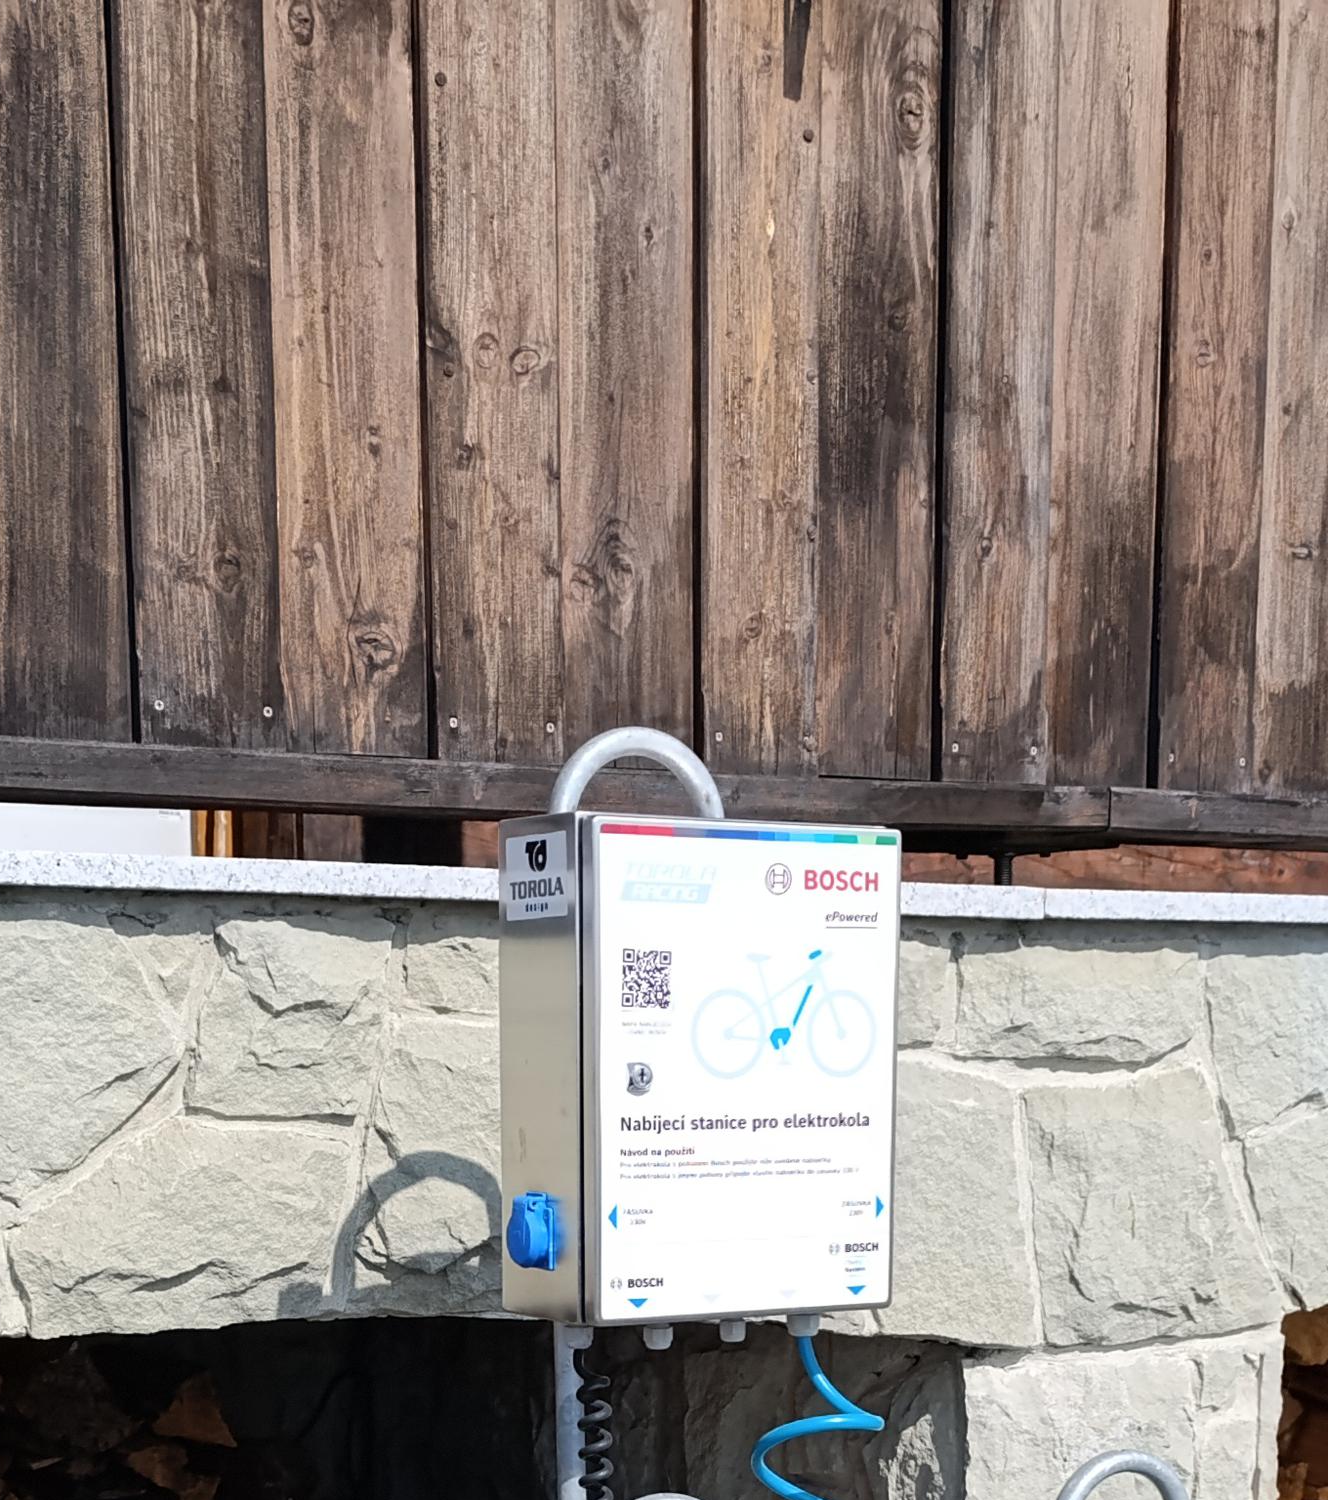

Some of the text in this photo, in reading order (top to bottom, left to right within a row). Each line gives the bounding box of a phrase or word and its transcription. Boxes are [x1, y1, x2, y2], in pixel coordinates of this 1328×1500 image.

[510, 877, 564, 900] TOROLA
[804, 869, 879, 892] BOSCH
[825, 911, 878, 923] ePowered
[691, 1114, 747, 1130] stanice
[752, 1118, 779, 1132] pro
[783, 1112, 870, 1128] elektrokola
[845, 1242, 879, 1253] BOSCH
[627, 1278, 664, 1289] BOSCH
